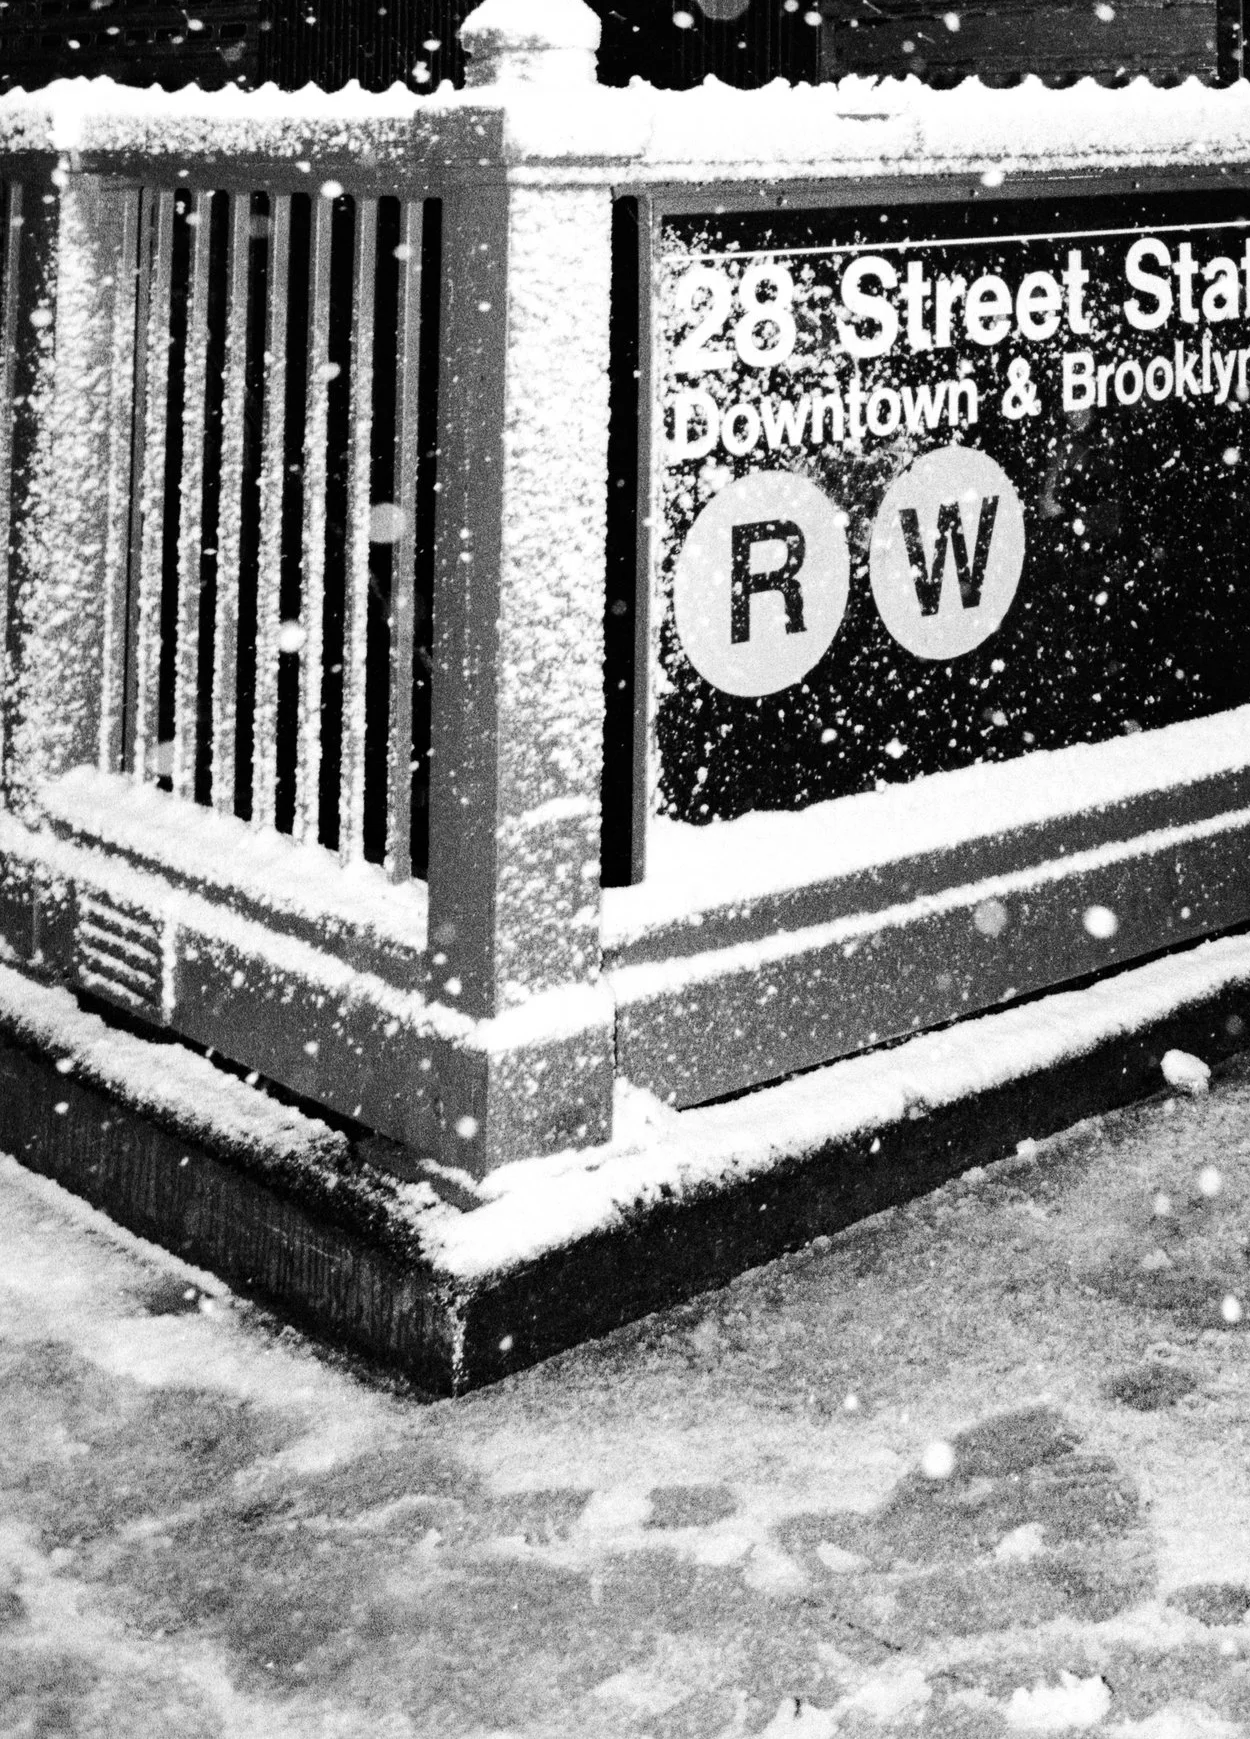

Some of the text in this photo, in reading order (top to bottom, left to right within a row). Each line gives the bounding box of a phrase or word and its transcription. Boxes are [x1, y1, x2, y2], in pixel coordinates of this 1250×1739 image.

[674, 263, 796, 372] 28
[839, 250, 1090, 360] Street
[674, 379, 978, 460] Downtown
[1002, 358, 1041, 420] &
[730, 494, 1000, 646] R W
